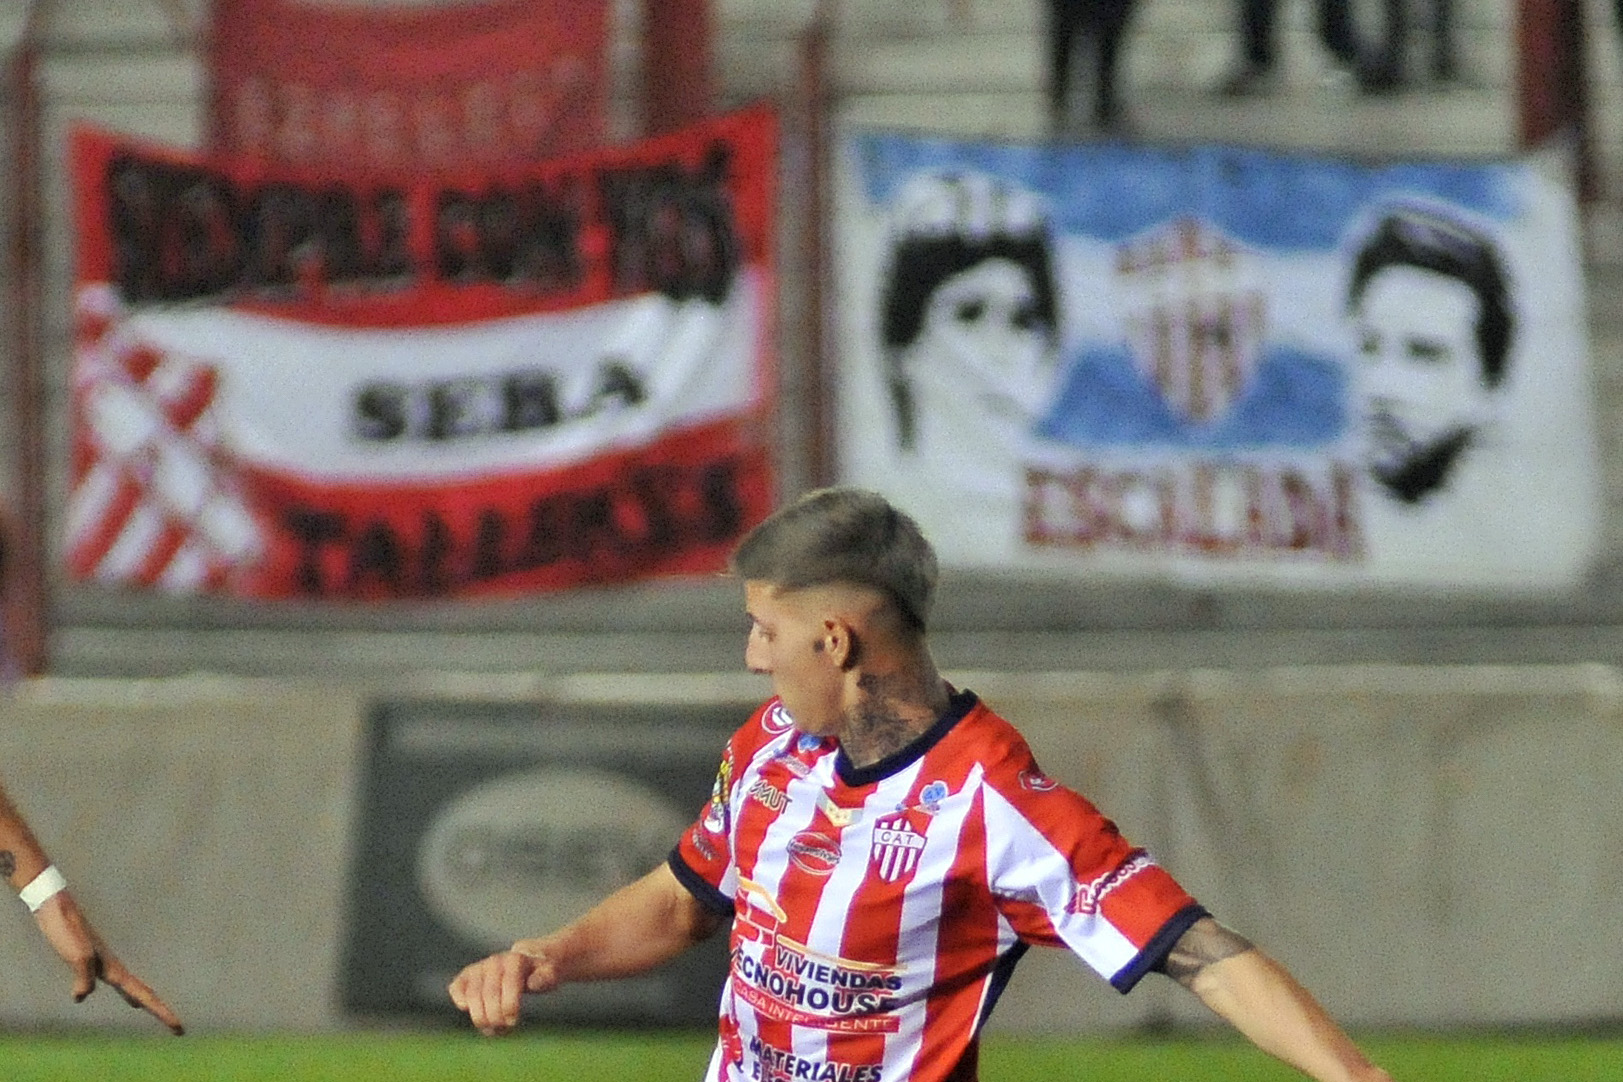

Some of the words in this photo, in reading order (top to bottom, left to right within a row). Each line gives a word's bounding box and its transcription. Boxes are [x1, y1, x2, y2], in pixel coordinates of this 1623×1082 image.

[352, 354, 650, 443] SEBA
[880, 830, 916, 846] CAT
[776, 944, 903, 990] VIVIENDAS
